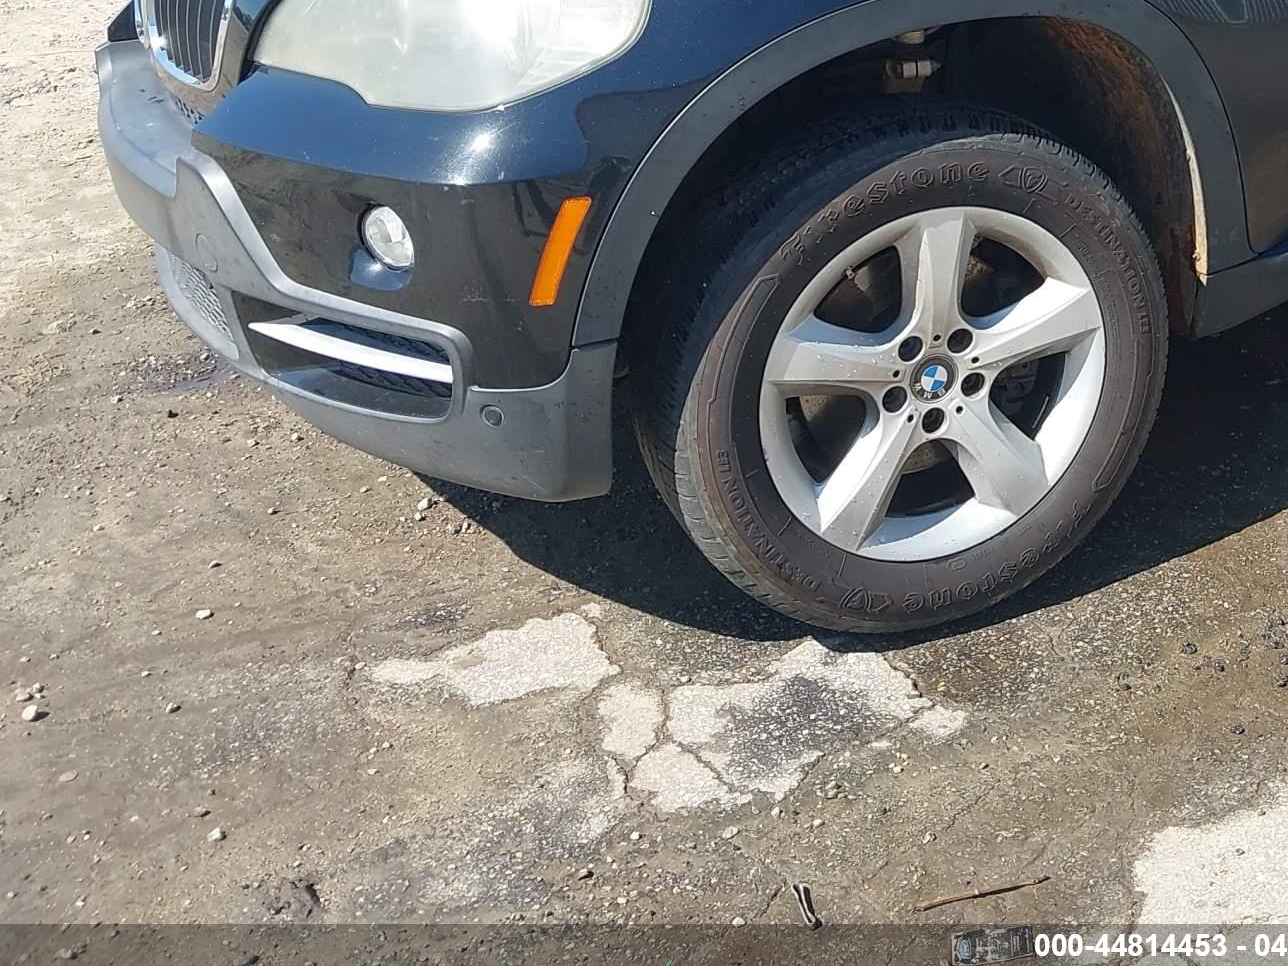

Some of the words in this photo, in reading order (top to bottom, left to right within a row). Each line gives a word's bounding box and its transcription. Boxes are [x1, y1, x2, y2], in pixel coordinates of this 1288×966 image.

[779, 161, 990, 266] Firestone
[1063, 192, 1147, 310] DESTINATION
[912, 381, 946, 399] BMW
[722, 476, 824, 593] DESTINATION
